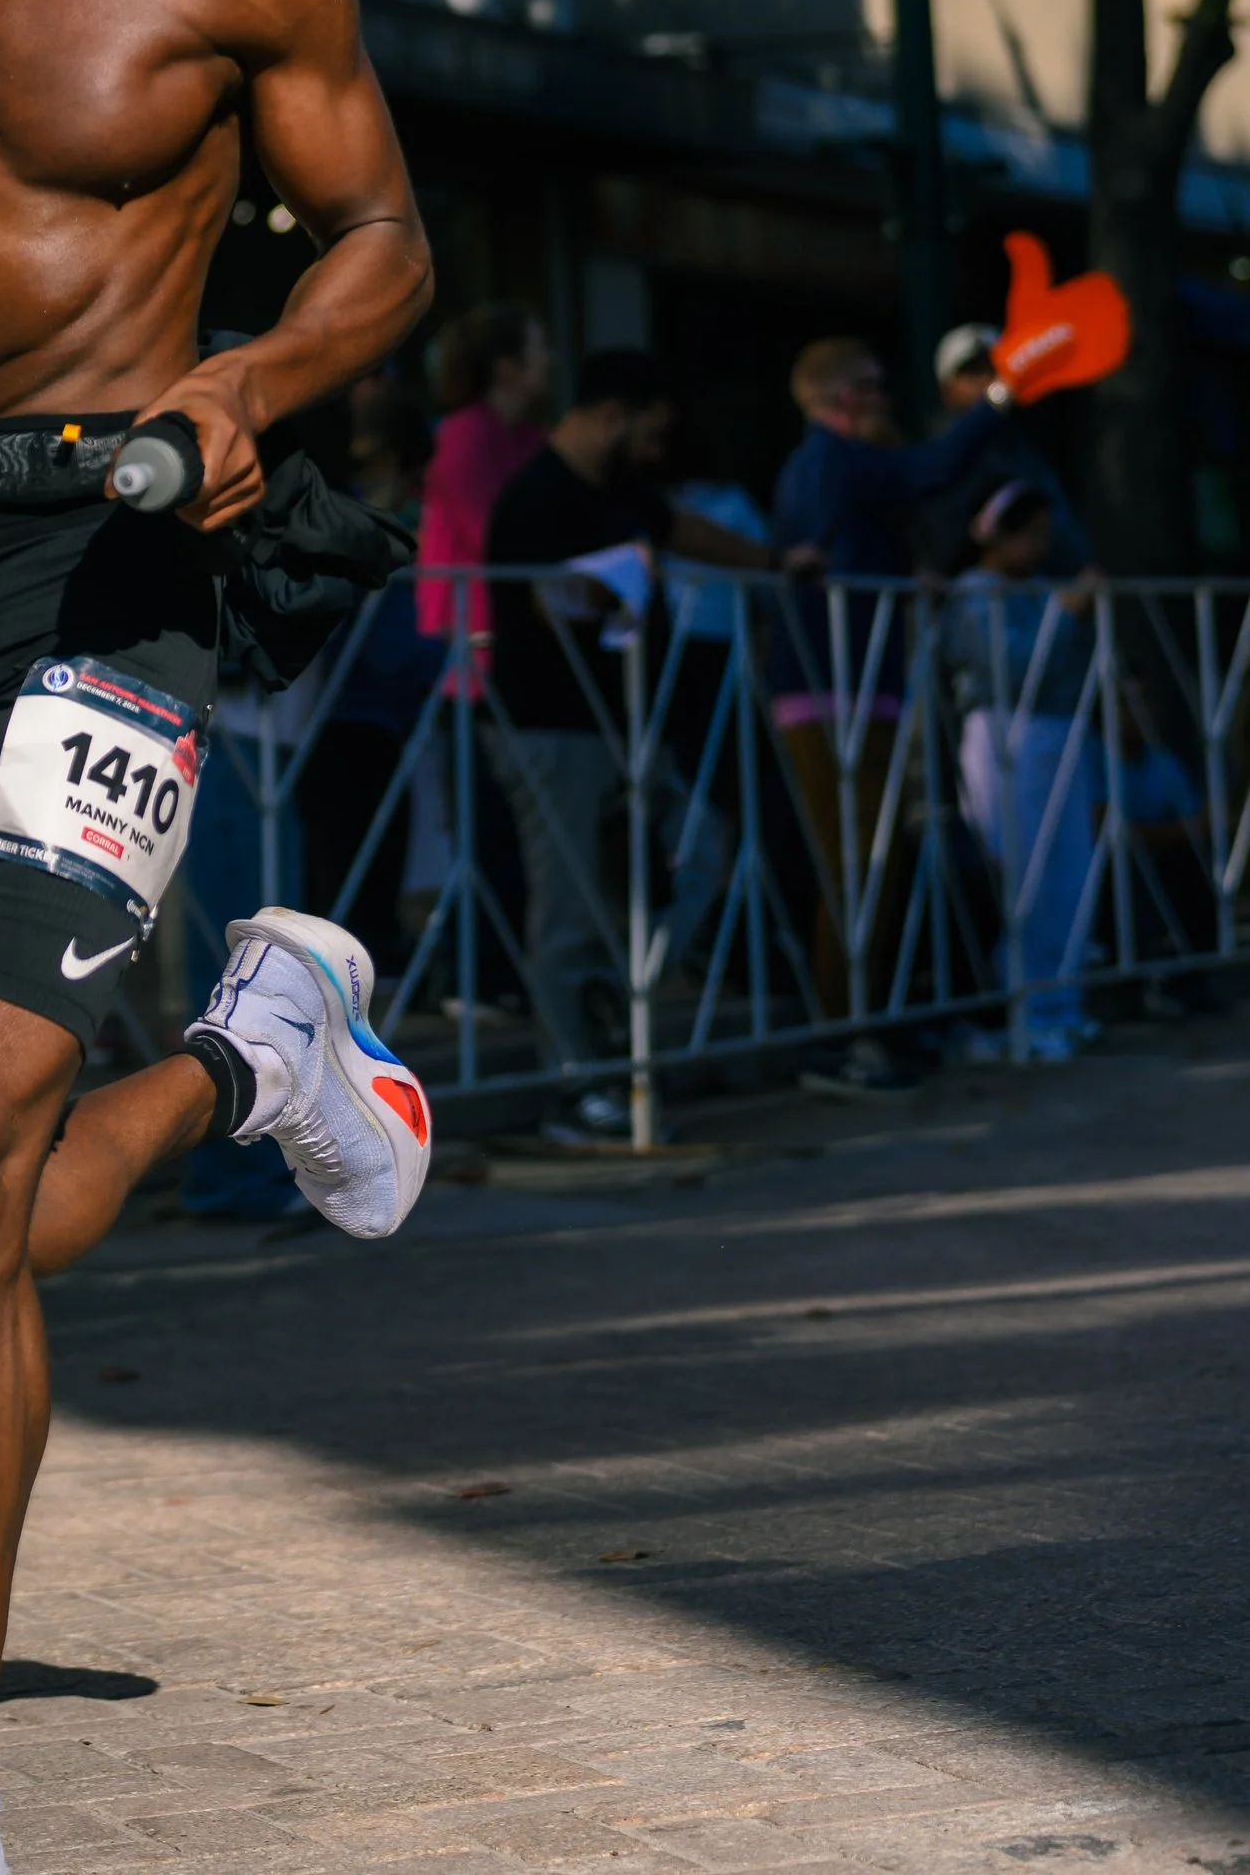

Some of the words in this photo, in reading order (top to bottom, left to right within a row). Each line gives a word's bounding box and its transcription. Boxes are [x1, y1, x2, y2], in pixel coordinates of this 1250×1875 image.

[76, 681, 115, 702] DECEMBER
[61, 731, 179, 835] 1410
[65, 795, 128, 834] MANNY
[129, 827, 155, 856] NCN
[85, 830, 120, 855] CORRAL
